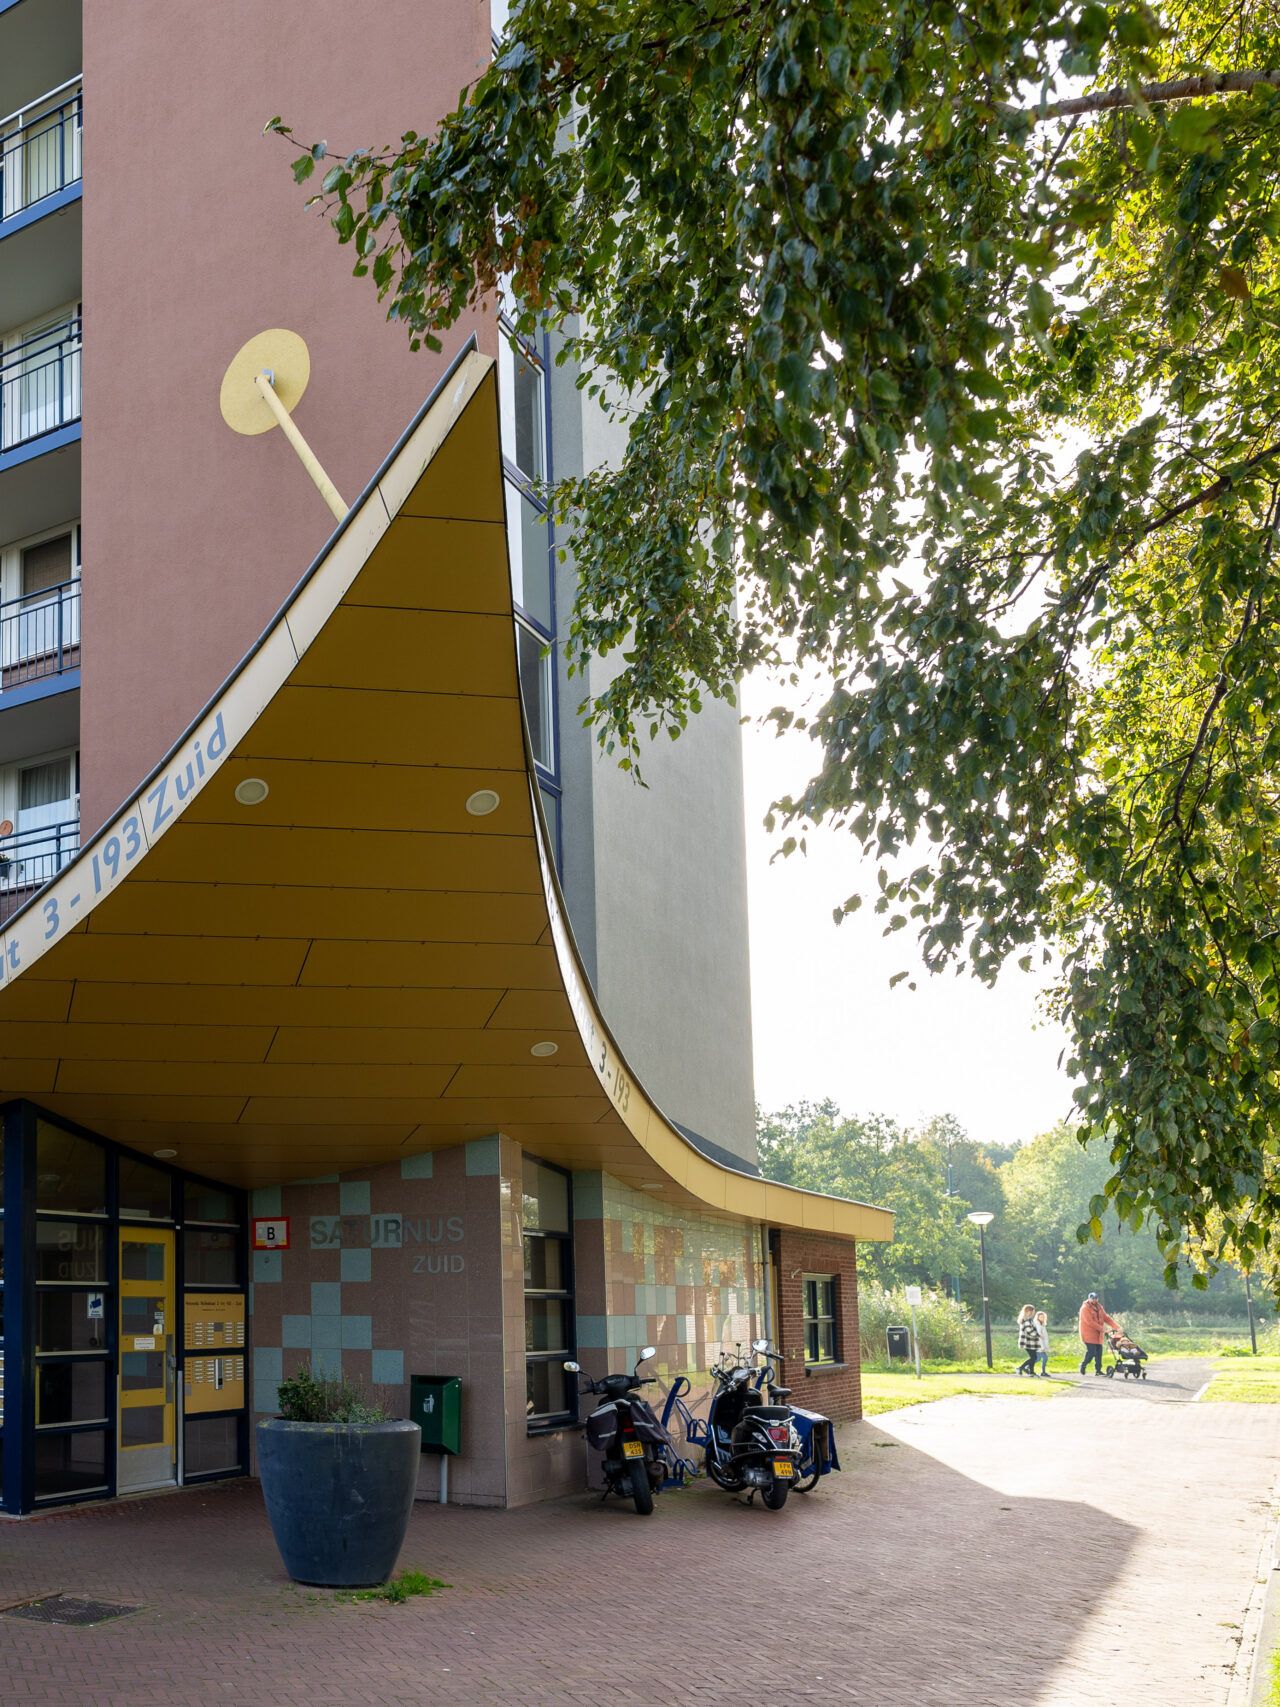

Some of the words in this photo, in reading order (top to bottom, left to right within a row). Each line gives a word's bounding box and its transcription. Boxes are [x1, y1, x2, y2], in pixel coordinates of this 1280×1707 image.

[43, 897, 59, 940] 3
[92, 816, 141, 894] 193
[148, 711, 227, 834] Zuid
[599, 1041, 606, 1073] 3
[613, 1067, 630, 1113] 193
[267, 1226, 275, 1241] B
[312, 1216, 464, 1245] SATURNUS
[413, 1255, 464, 1273] ZUID
